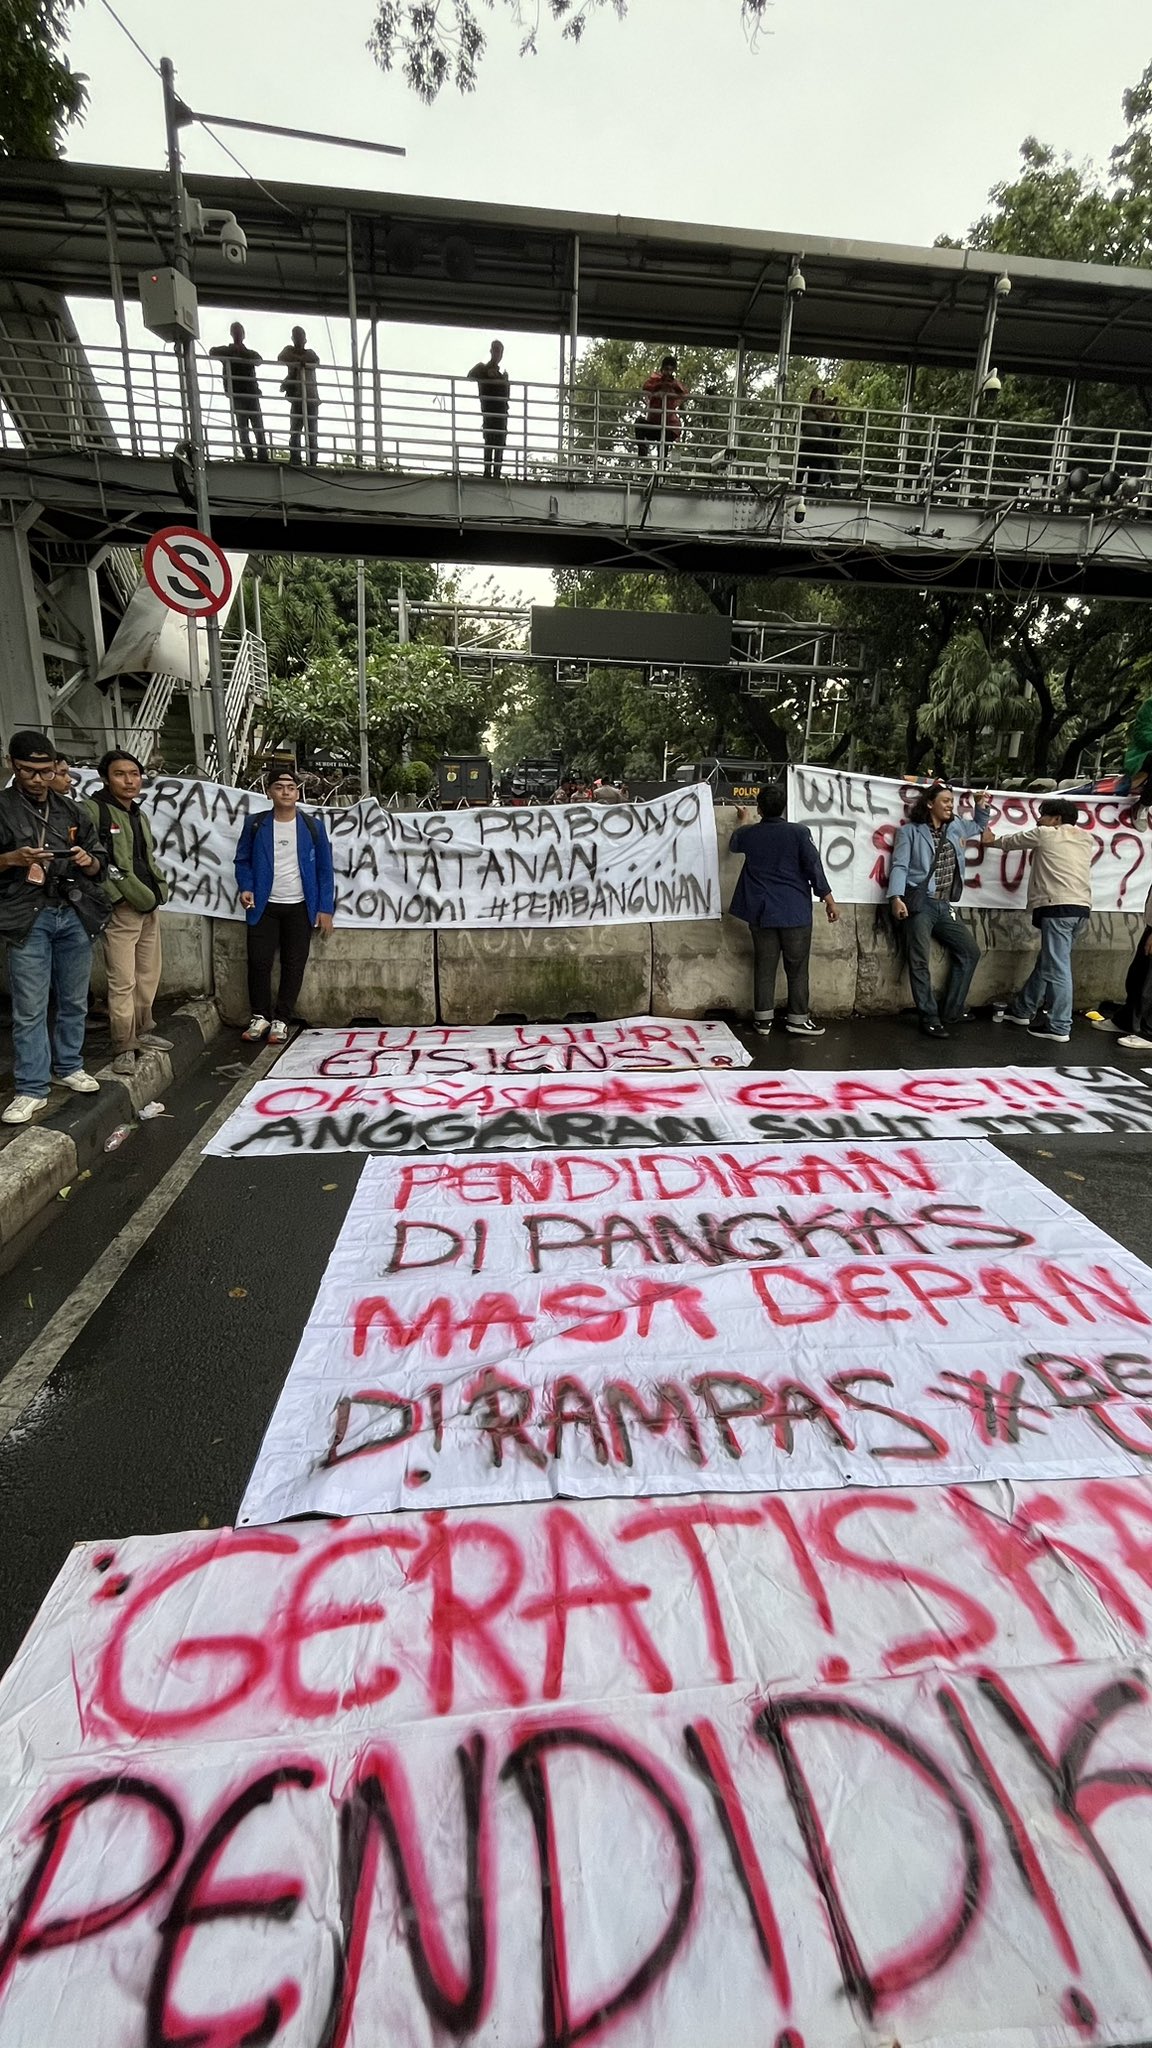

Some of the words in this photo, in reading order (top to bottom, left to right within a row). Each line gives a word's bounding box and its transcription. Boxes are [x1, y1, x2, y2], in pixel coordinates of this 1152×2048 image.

[474, 793, 700, 844] PRABOWO
[797, 768, 889, 819] WILL
[333, 886, 466, 923] KONOMI
[476, 872, 713, 923] #PEMBANGUNAN
[335, 1029, 477, 1049] TUT
[231, 1110, 718, 1151] ANGGARAN
[749, 1112, 934, 1140] SULIT
[397, 1145, 940, 1208] PENDIDIKAN
[386, 1216, 484, 1273] DI
[523, 1204, 1035, 1274] PANGKAS
[350, 1280, 720, 1358] MASA
[748, 1261, 1152, 1328] DEPAN
